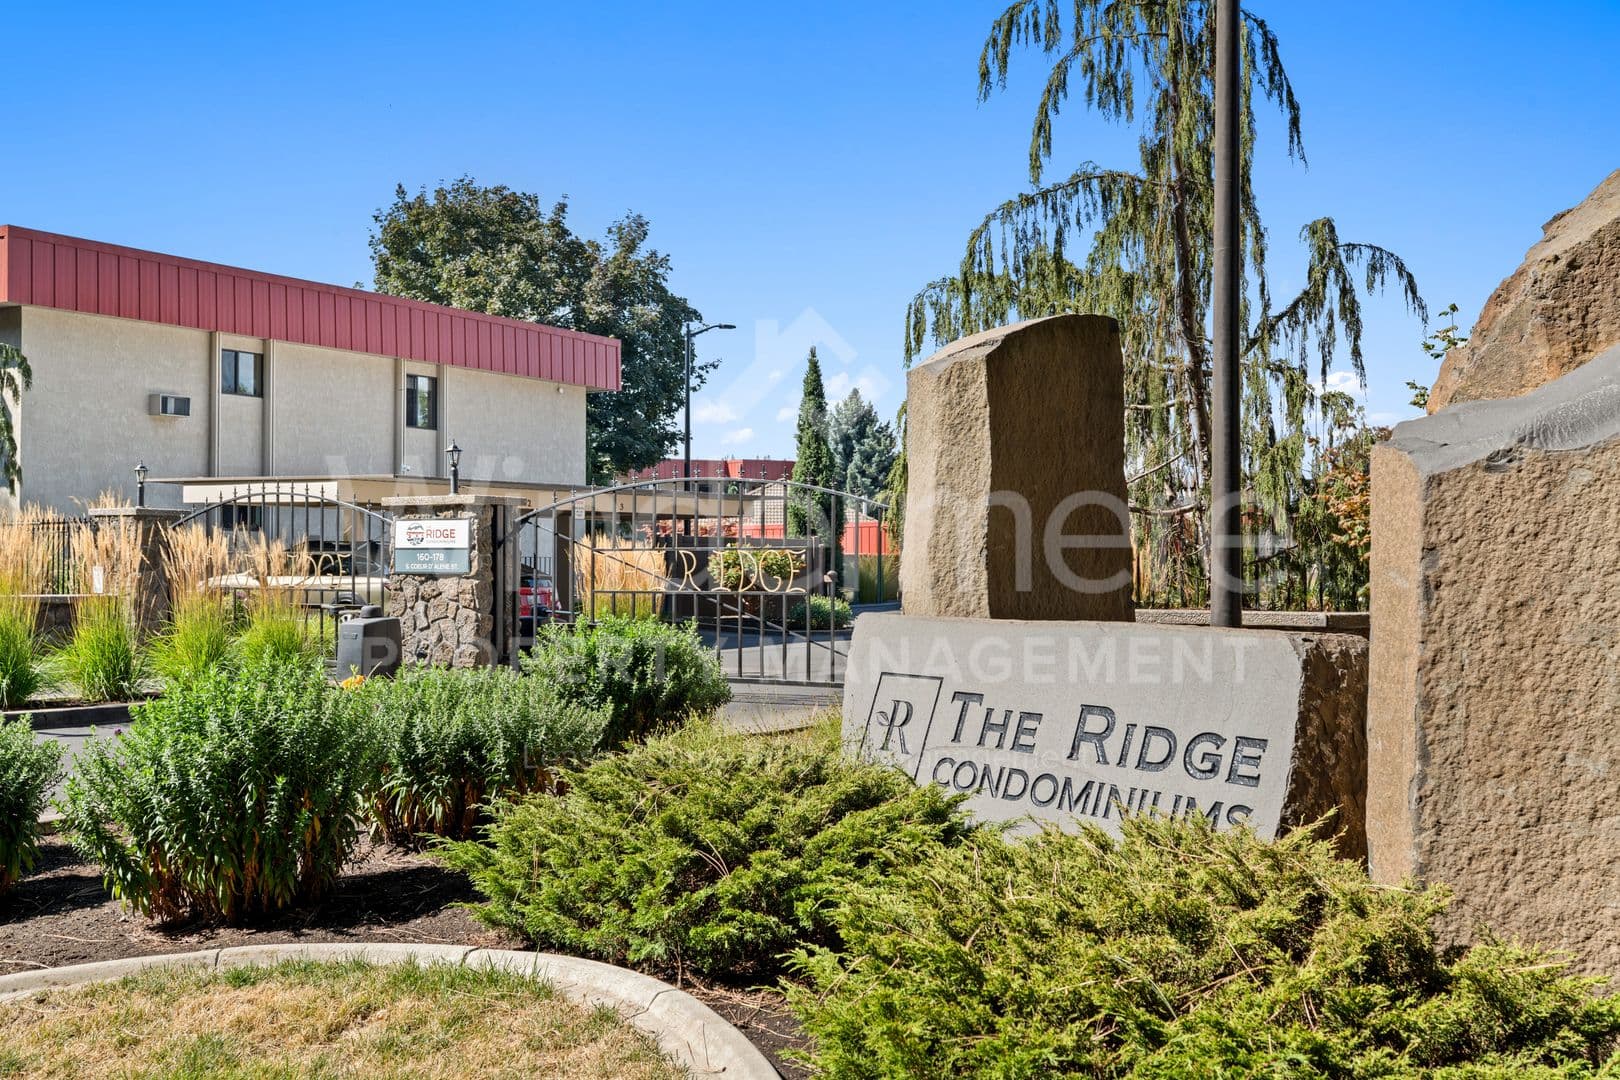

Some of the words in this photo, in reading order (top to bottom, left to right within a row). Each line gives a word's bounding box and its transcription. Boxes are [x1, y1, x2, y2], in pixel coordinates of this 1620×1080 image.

[426, 529, 456, 539] RIDGE
[417, 553, 445, 561] 160-178
[678, 549, 807, 592] RIDGE
